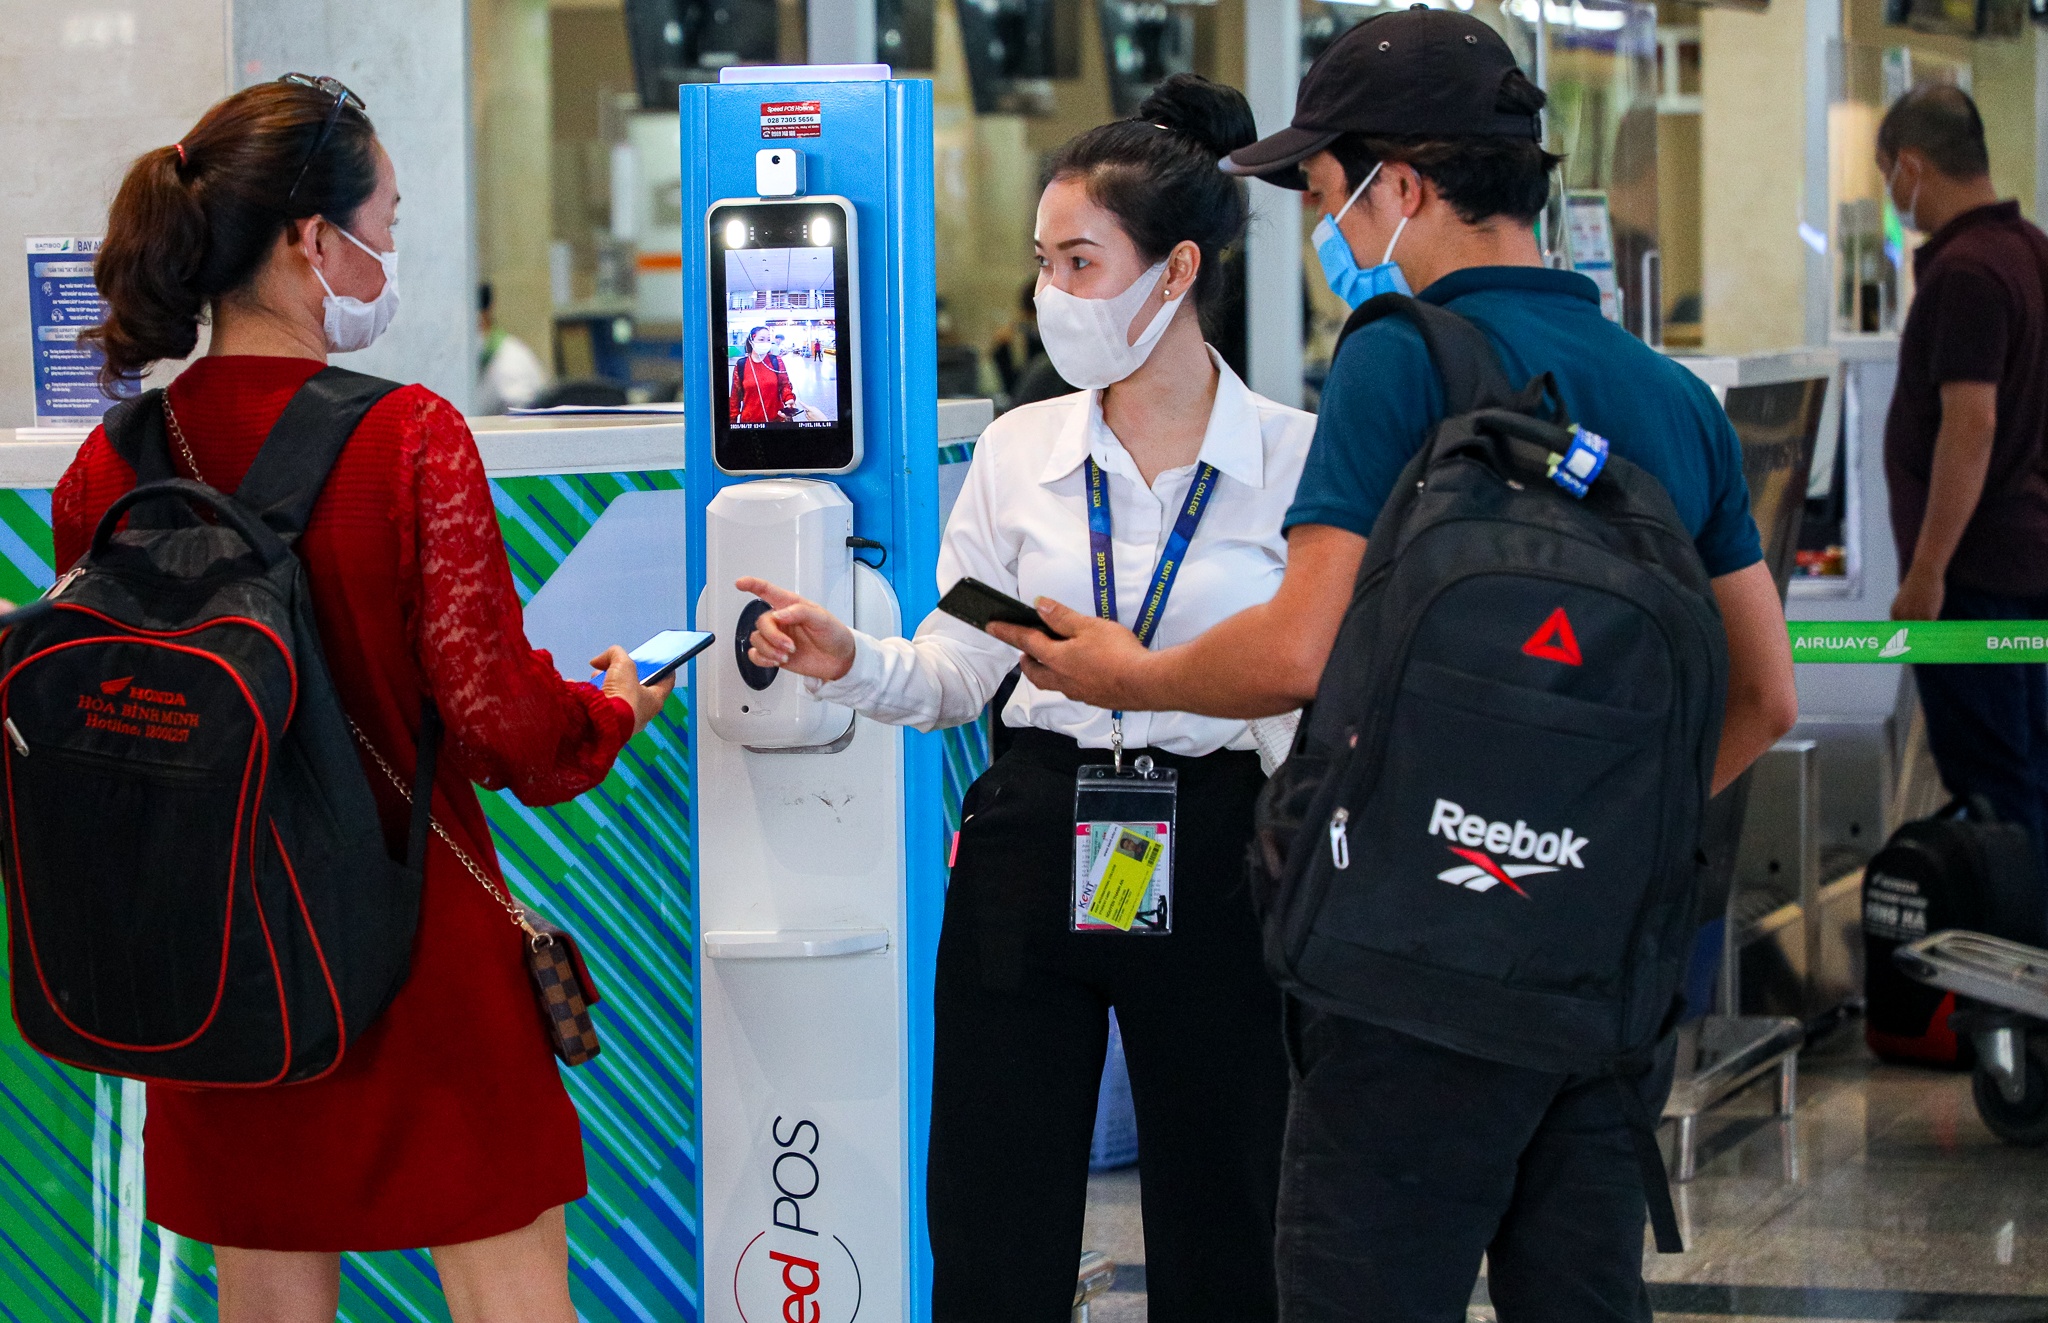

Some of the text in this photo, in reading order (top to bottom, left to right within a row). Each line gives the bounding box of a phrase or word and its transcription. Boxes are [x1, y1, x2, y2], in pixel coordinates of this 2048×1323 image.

[77, 241, 92, 252] BAY
[1093, 490, 1102, 508] KENT
[1187, 482, 1207, 516] COLLEGE
[1097, 552, 1107, 587] COLLEGE
[1160, 560, 1174, 581] KENT
[1794, 636, 1879, 649] AIRWAYS
[1987, 636, 2048, 650] BAMB
[129, 686, 187, 707] HONDA
[161, 711, 200, 727] MINH
[1428, 798, 1590, 869] Reebok
[772, 1115, 820, 1237] POS
